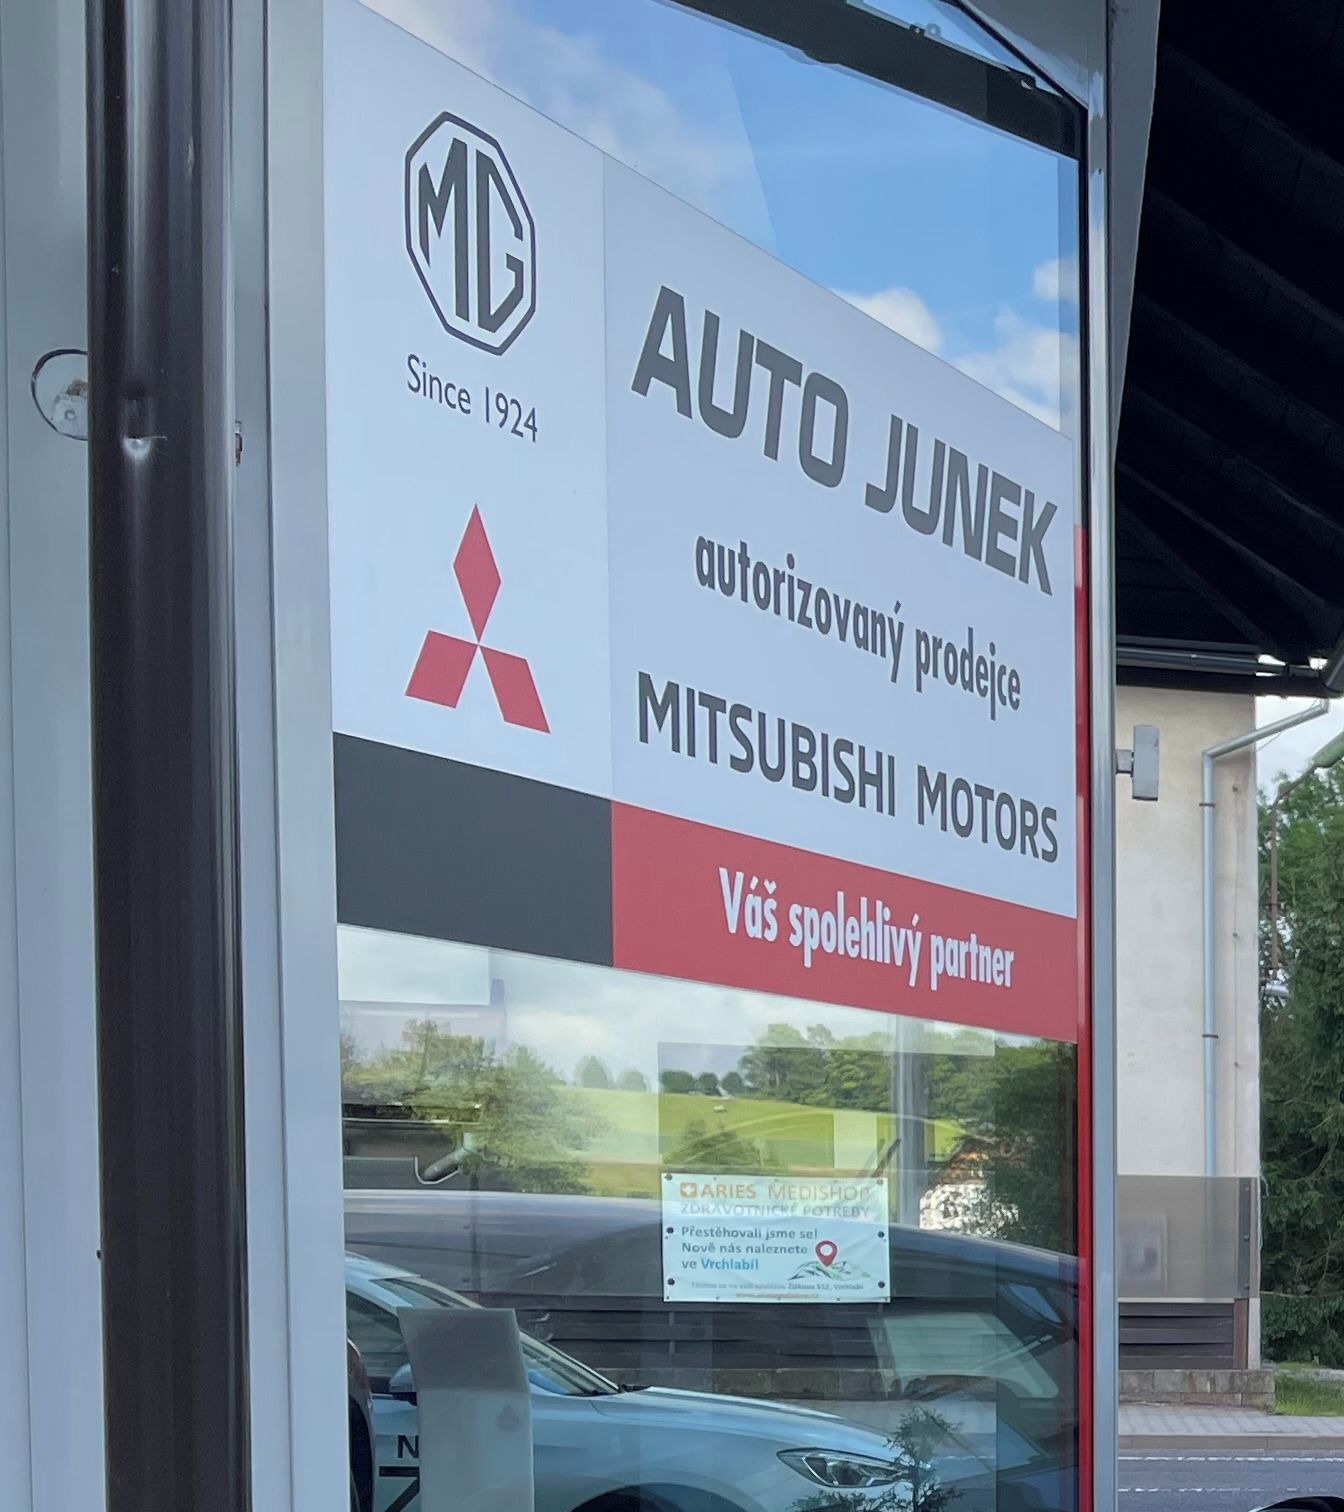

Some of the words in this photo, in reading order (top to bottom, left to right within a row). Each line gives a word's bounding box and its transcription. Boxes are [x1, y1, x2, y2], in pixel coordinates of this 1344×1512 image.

[418, 136, 525, 334] MG
[406, 353, 472, 415] Since
[484, 385, 538, 443] 1924
[631, 284, 849, 489] AUTO
[864, 412, 1058, 596] JUNEK
[695, 534, 905, 684] autorizovaný
[915, 625, 1022, 722] prodejce
[637, 670, 897, 817] MITSUBISHI
[917, 764, 1059, 864] MOTORS
[718, 866, 779, 942] Váš
[788, 891, 923, 988] spolehlivý
[929, 932, 1016, 992] partner
[681, 1226, 762, 1239] Přestěhovali
[765, 1230, 796, 1241] jsme
[701, 1183, 757, 1199] ARIES
[768, 1185, 870, 1201] MEDISHOP
[682, 1243, 716, 1254] Nově
[719, 1242, 742, 1254] nás
[745, 1243, 808, 1254] naleznete
[682, 1261, 697, 1270] ve
